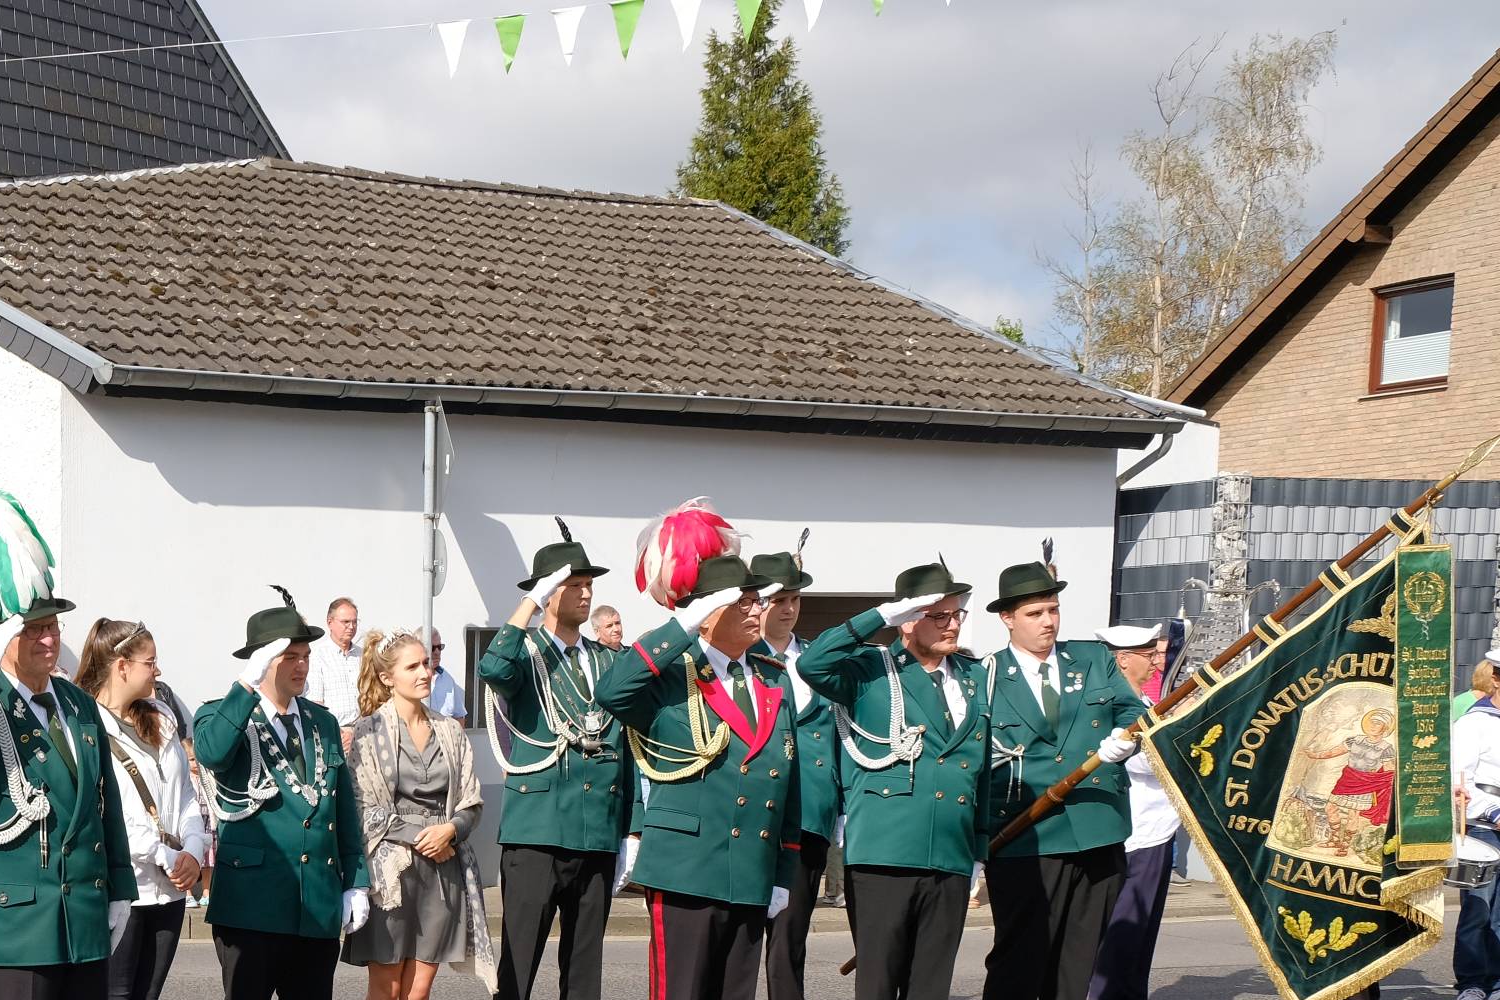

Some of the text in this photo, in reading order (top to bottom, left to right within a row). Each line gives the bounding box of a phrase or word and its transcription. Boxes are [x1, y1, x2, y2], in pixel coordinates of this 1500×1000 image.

[1414, 581, 1434, 595] 125
[1416, 719, 1435, 733] 1876
[1225, 777, 1249, 808] ST.
[1227, 814, 1272, 835] 1876
[1271, 854, 1381, 899] HAMIC
